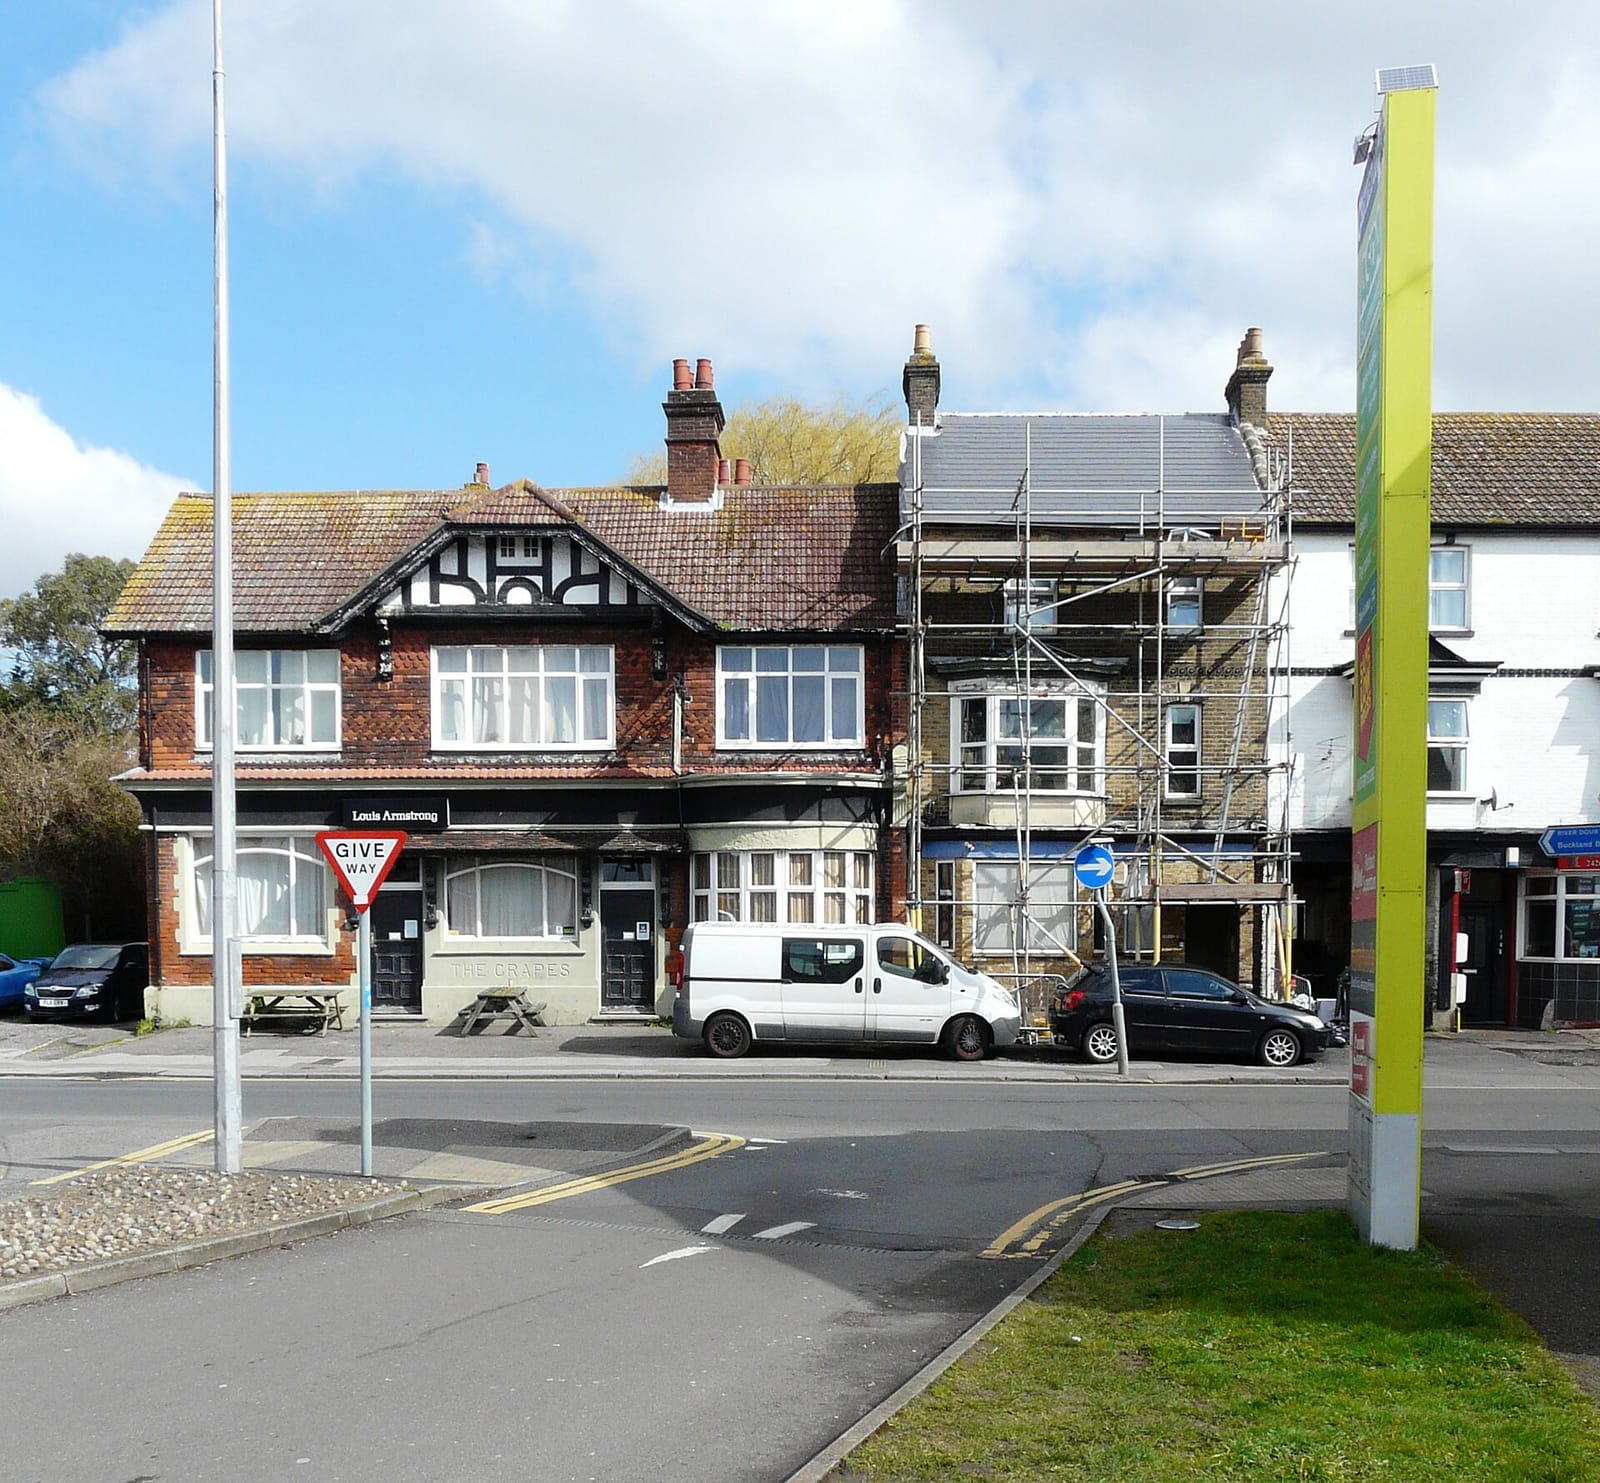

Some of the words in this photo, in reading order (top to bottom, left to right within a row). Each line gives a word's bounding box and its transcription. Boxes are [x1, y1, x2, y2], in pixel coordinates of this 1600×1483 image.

[352, 810, 381, 821] Louis
[382, 810, 438, 823] Armstrong
[336, 843, 385, 858] GIVE
[1557, 841, 1593, 849] Buckland
[346, 864, 376, 874] WAY
[451, 963, 487, 977] THE
[494, 963, 570, 977] GRAPES
